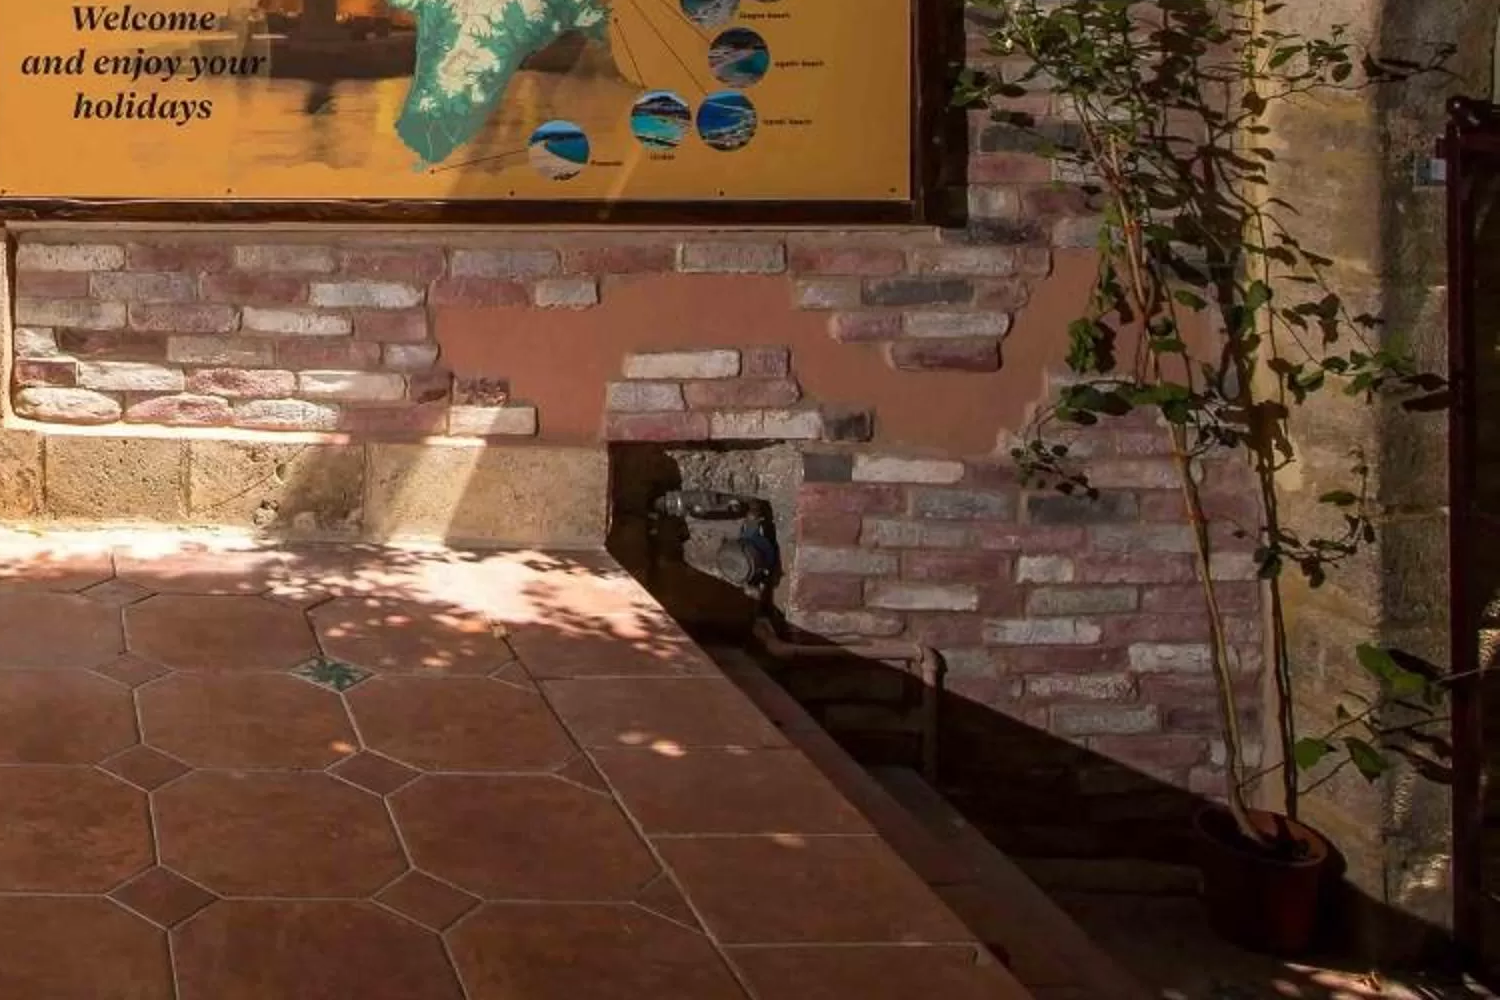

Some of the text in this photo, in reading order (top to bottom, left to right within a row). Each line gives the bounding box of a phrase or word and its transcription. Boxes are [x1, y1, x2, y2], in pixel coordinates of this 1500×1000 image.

[72, 4, 216, 32] Welcome
[21, 48, 267, 82] and enjoy your
[73, 91, 213, 125] holidays
